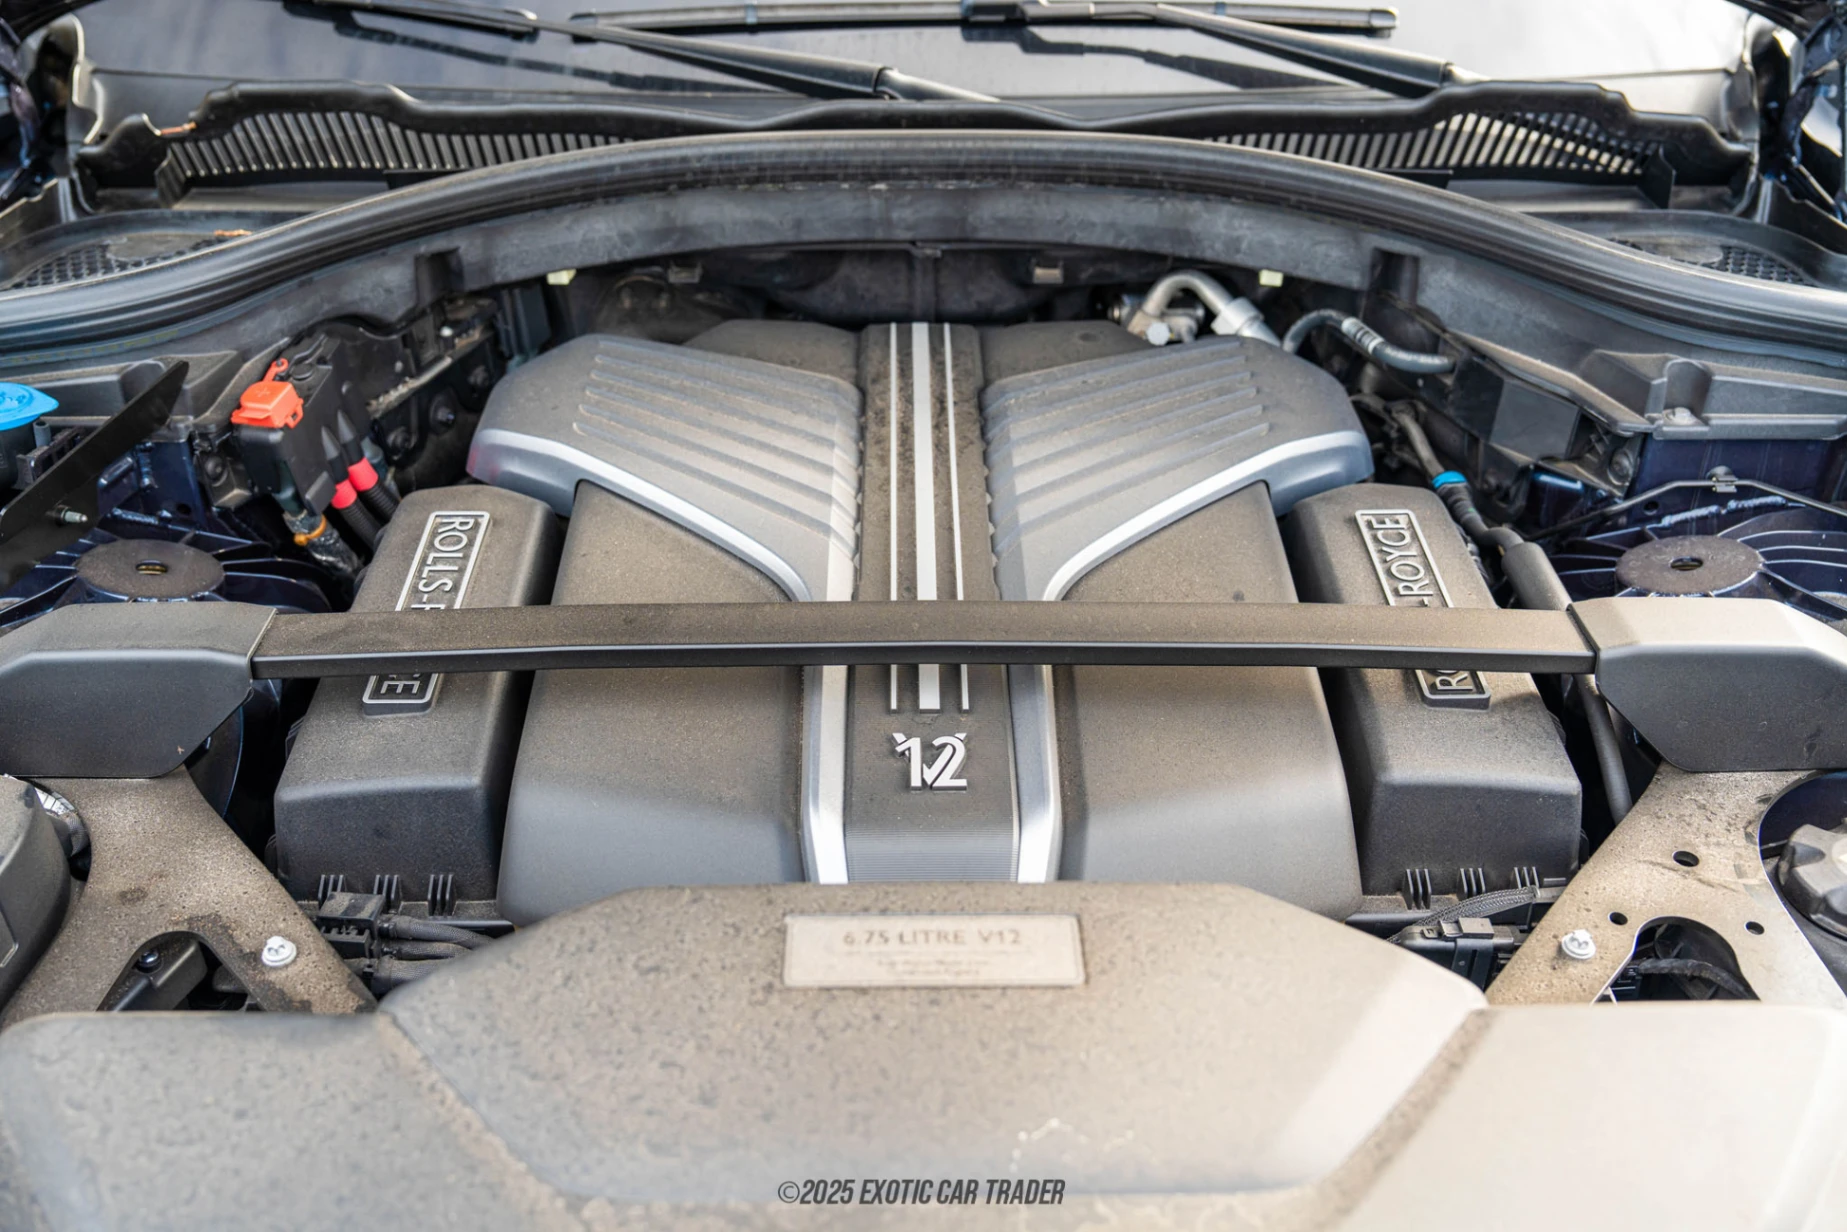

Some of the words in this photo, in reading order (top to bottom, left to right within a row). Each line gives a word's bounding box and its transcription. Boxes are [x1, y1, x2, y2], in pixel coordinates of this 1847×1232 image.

[380, 517, 475, 694] ROLLS-E
[1368, 514, 1474, 691] R-ROYCE
[898, 929, 966, 946] LITRE
[977, 928, 1022, 945] V12
